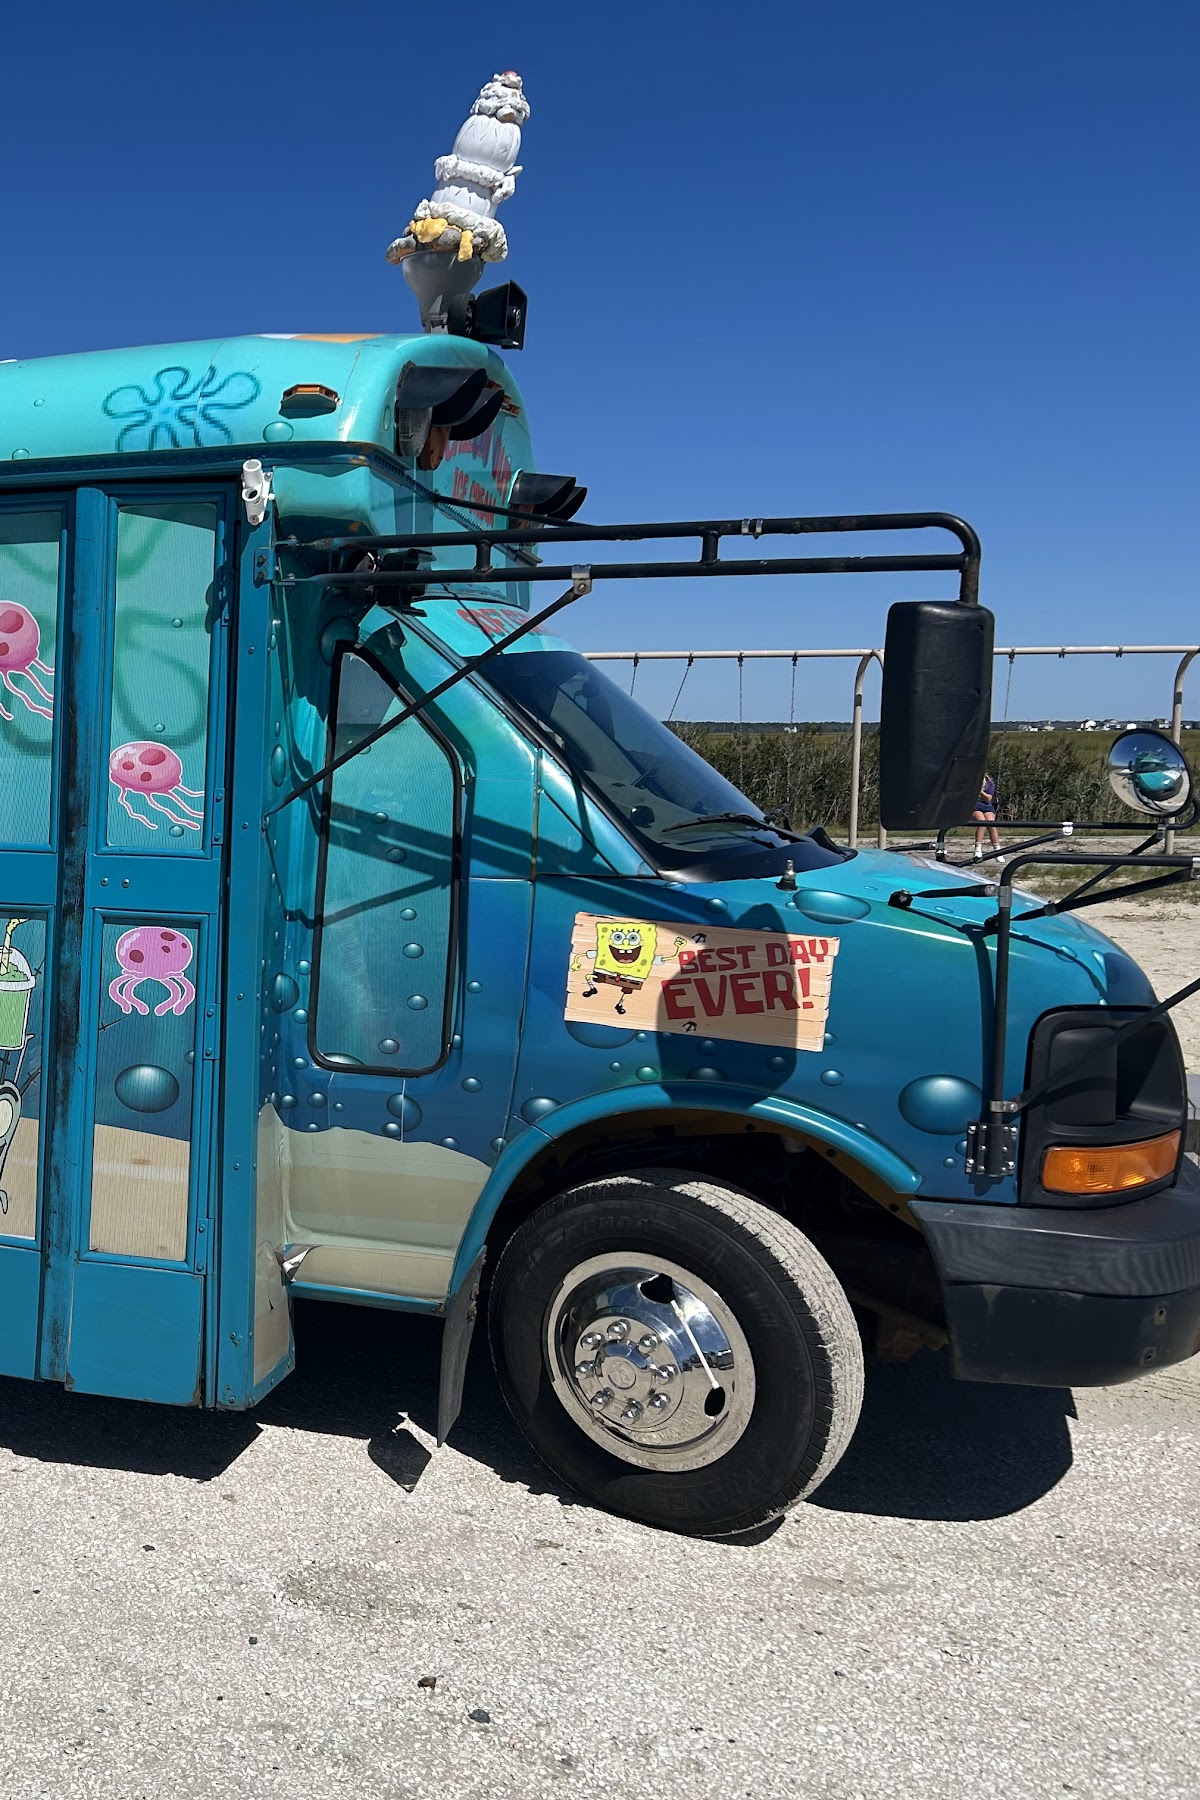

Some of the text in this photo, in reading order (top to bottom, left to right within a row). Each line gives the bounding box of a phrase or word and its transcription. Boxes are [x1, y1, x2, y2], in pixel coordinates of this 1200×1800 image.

[678, 939, 829, 975] BEST DAY
[661, 967, 814, 1020] EVER!
